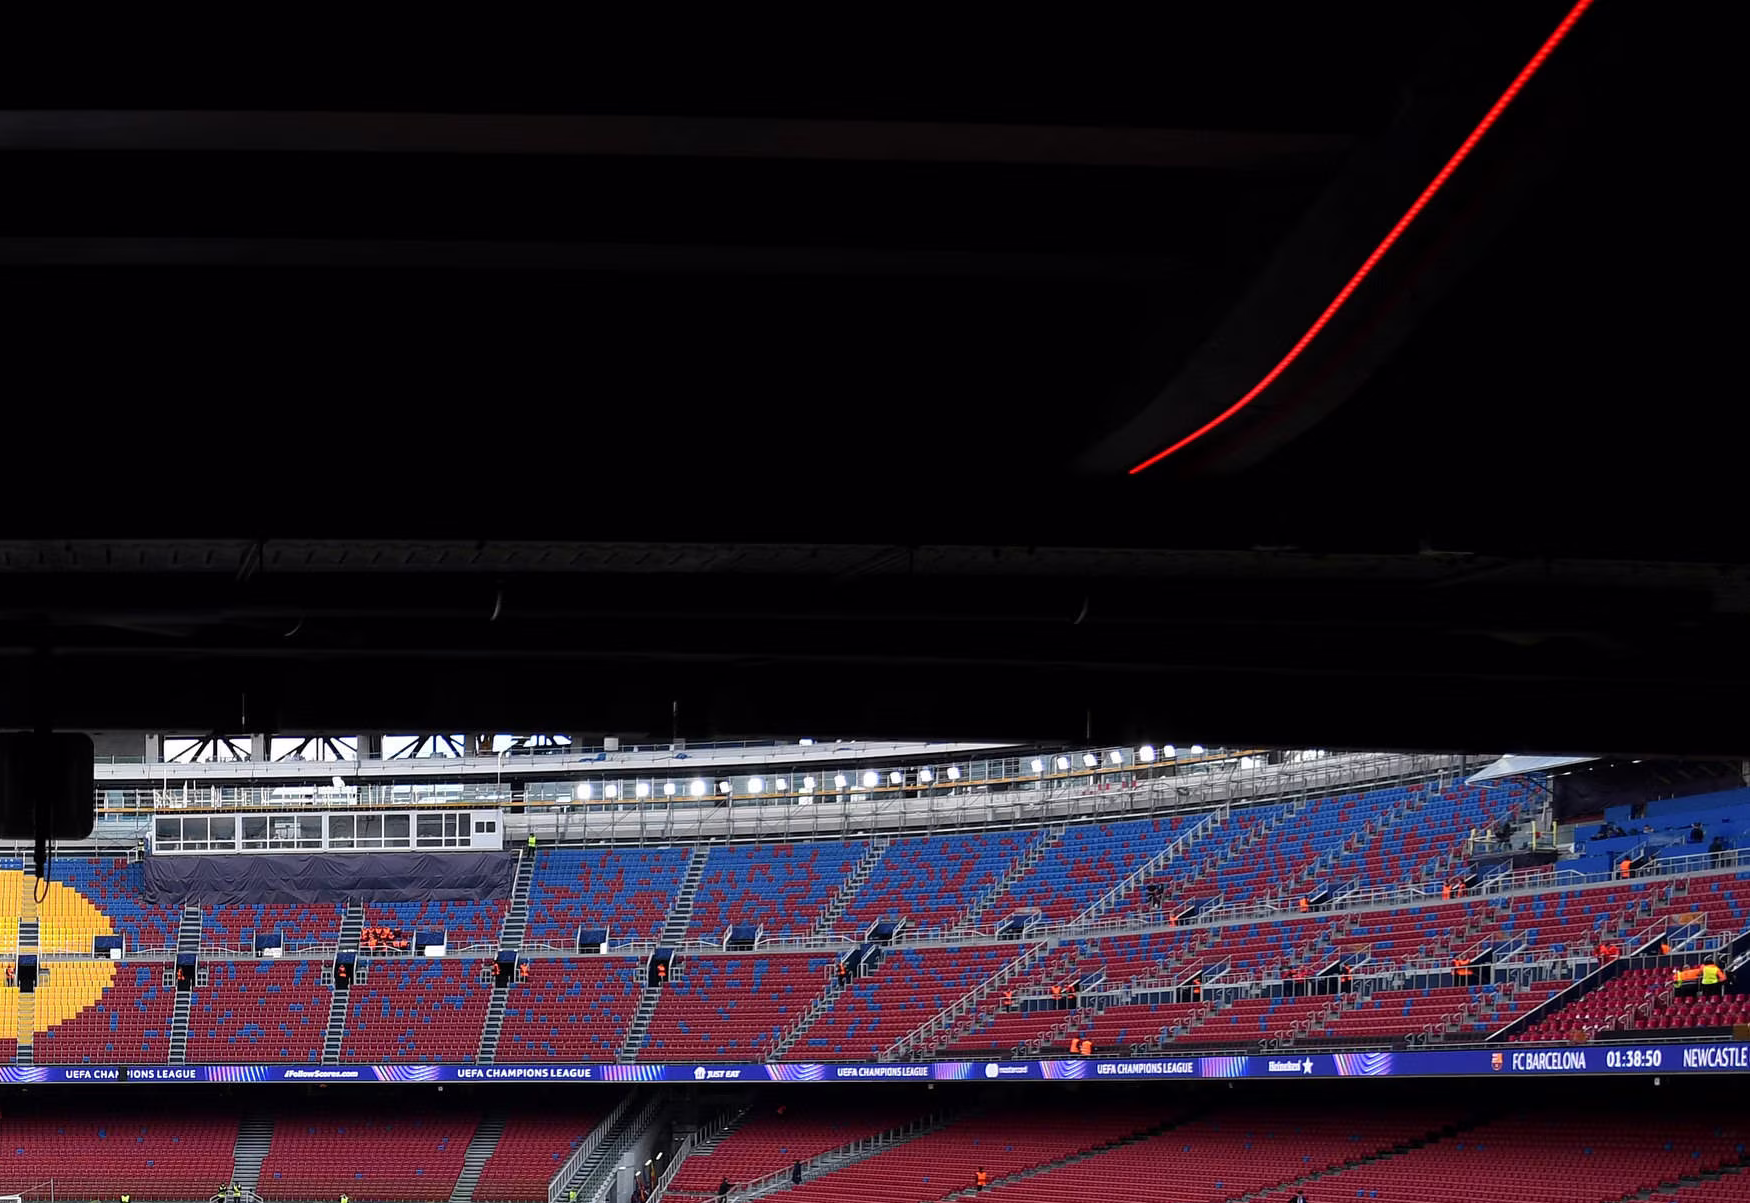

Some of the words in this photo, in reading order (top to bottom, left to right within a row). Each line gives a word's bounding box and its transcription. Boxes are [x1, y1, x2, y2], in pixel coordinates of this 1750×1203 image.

[1512, 1053, 1526, 1070] FC
[1526, 1052, 1586, 1070] BARCELONA
[1606, 1050, 1662, 1067] 01:38:50
[1683, 1047, 1748, 1067] NEWCASTLE
[65, 1070, 92, 1079] UEFA
[156, 1069, 196, 1079] LEAGUE
[457, 1069, 484, 1078] UEFA
[485, 1069, 549, 1078] CHAMPIONS
[550, 1068, 592, 1078] LEAGUE
[707, 1070, 725, 1078] JUST
[725, 1070, 741, 1078] EAT
[837, 1068, 858, 1077] UEFA
[858, 1067, 901, 1077] CHAMPIONS
[901, 1067, 929, 1076] LEAGUE
[1097, 1064, 1117, 1075] UEFA
[1117, 1063, 1162, 1074] CHAMPIONS
[1162, 1062, 1194, 1073] LEAGUE
